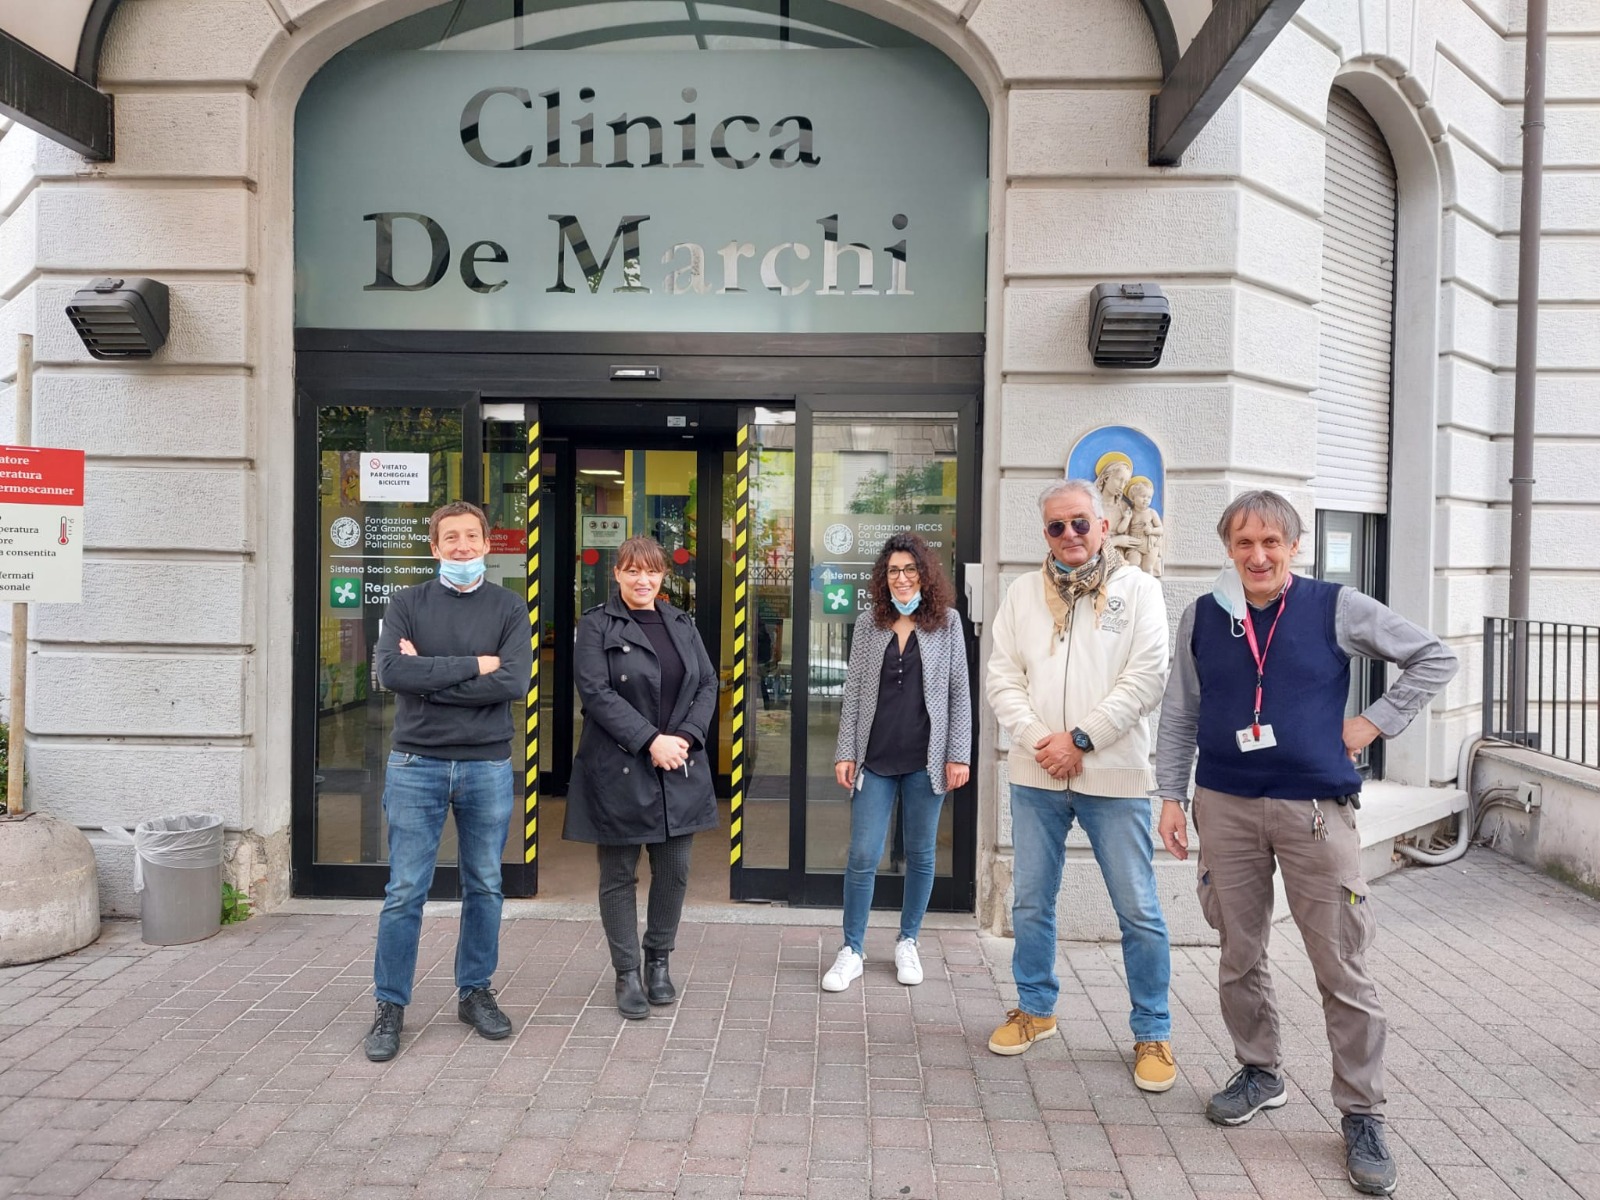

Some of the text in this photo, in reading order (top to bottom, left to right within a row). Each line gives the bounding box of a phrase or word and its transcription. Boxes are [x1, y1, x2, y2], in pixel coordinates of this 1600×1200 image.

[459, 86, 822, 170] Clinica
[363, 211, 915, 296] De Marchi
[364, 516, 418, 525] Fondazione
[380, 525, 412, 533] Granda
[858, 523, 943, 532] Fondazione IRCCS
[364, 532, 406, 542] Ospedale
[364, 541, 413, 549] Policlinico
[6, 549, 57, 557] consentita
[330, 565, 434, 574] Sistema Socio Sanitario
